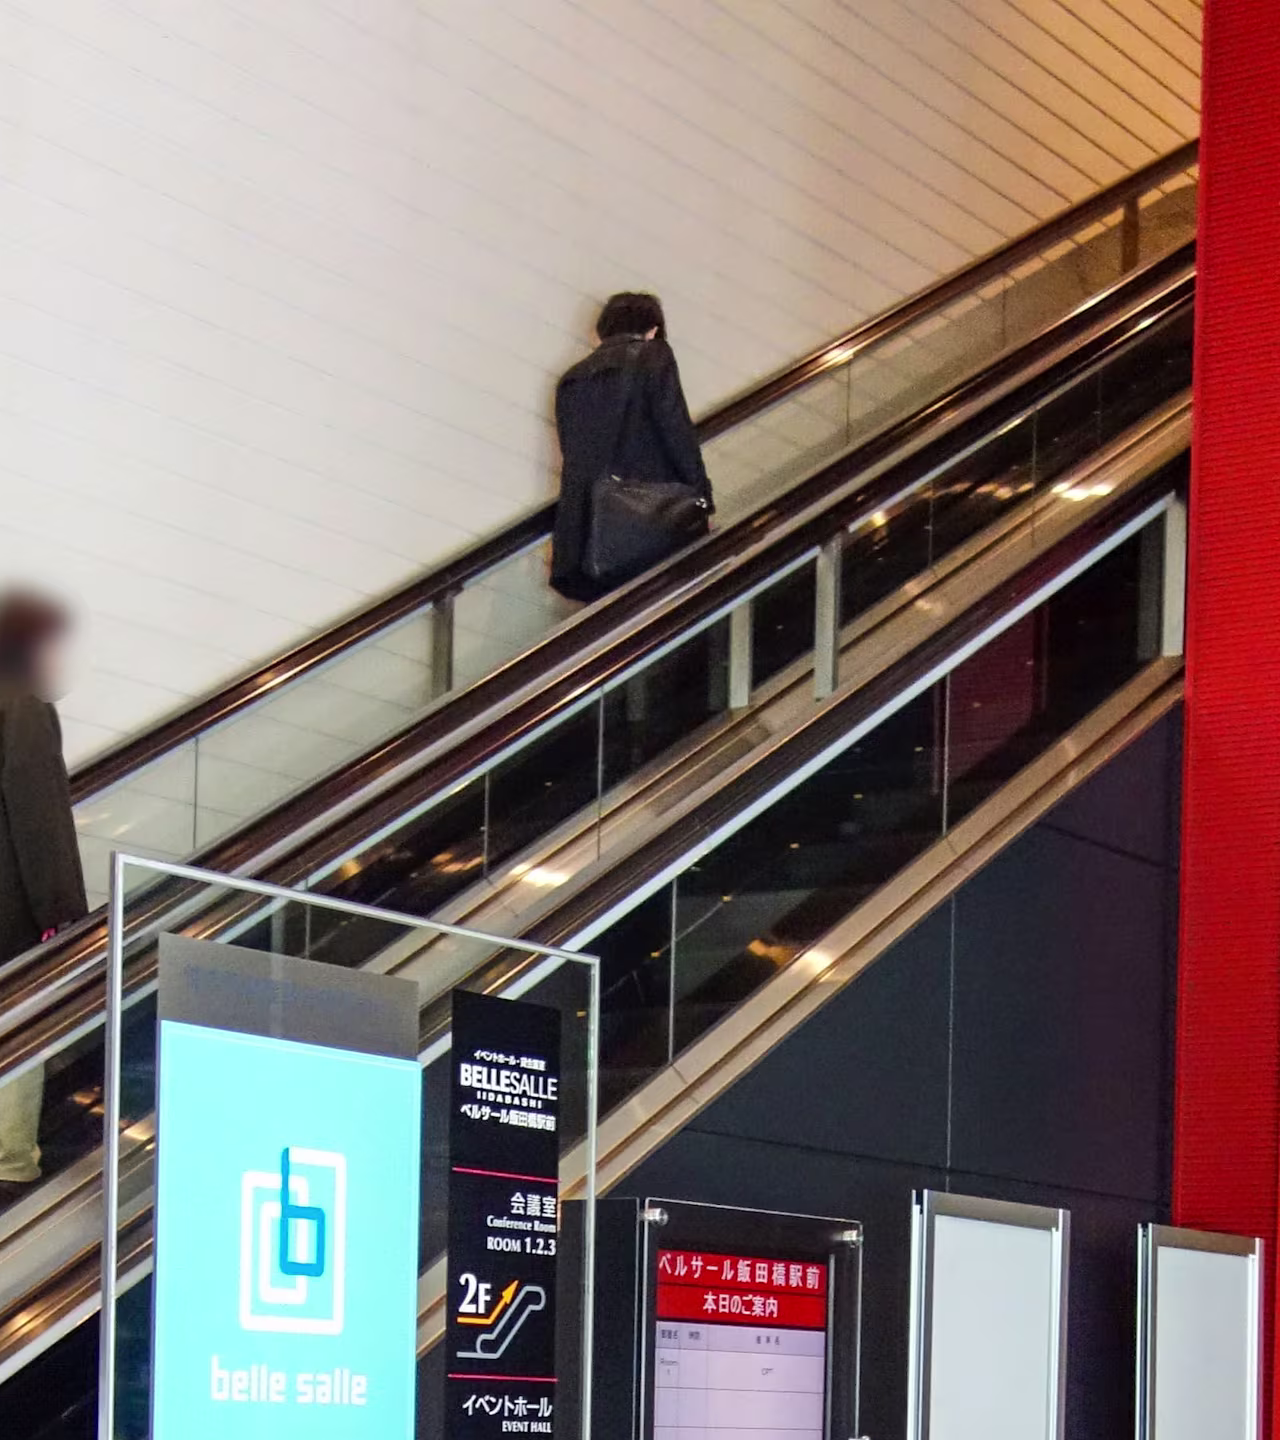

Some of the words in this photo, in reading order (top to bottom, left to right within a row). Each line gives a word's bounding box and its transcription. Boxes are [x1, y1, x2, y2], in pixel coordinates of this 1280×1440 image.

[460, 1063, 558, 1100] BELLESALLE
[476, 1090, 542, 1109] IIDABASHI
[510, 1192, 557, 1218] 会議室
[486, 1236, 522, 1252] ROOM
[524, 1237, 557, 1256] 1.2.3
[659, 1253, 821, 1290] ベルサール飯田橋駅前
[458, 1273, 492, 1314] 2F
[703, 1291, 778, 1318] 本日のご案内
[210, 1354, 286, 1402] belle
[296, 1368, 368, 1406] salle
[462, 1394, 553, 1418] イベントホール
[501, 1420, 529, 1433] EVENT
[530, 1421, 552, 1433] HALL
